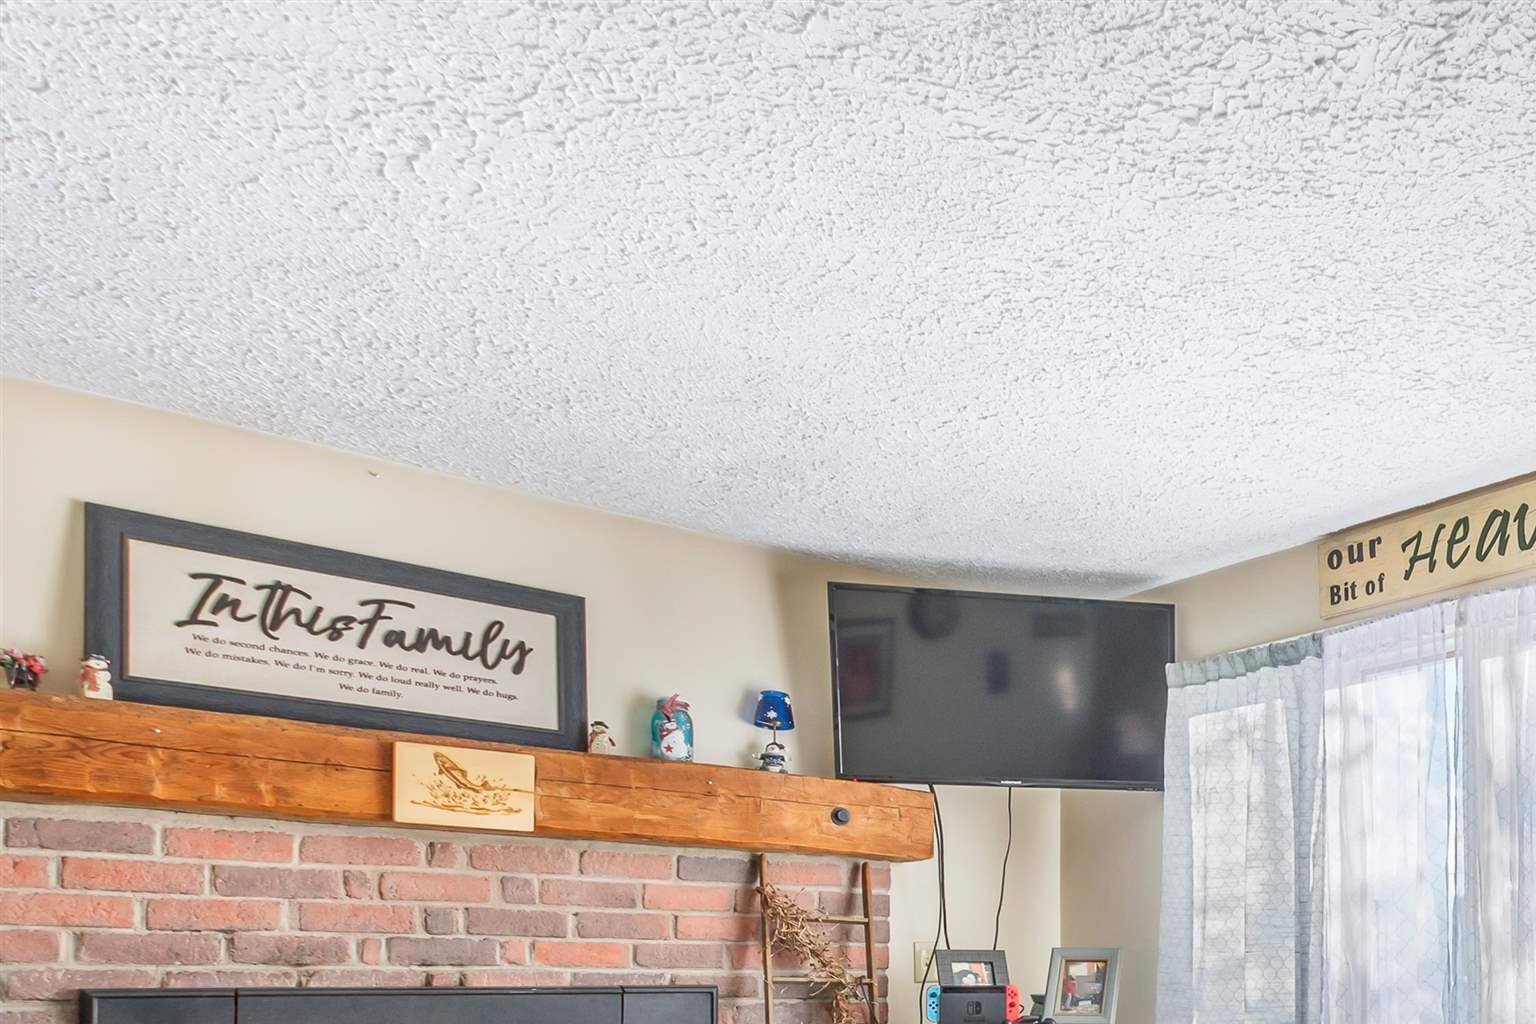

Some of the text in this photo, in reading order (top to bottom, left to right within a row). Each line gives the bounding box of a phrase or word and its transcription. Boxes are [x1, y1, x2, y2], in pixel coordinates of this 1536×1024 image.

[1327, 536, 1382, 570] our
[1329, 573, 1386, 606] Bit of
[174, 573, 257, 627] In
[358, 599, 534, 675] Family
[185, 647, 519, 702] We do mistakes. We do I'm sorry. We do loud really well. We do hugs.
[192, 633, 499, 685] We do second chances. We do grace. We do real. We do prayers.
[339, 682, 403, 700] We do family.
